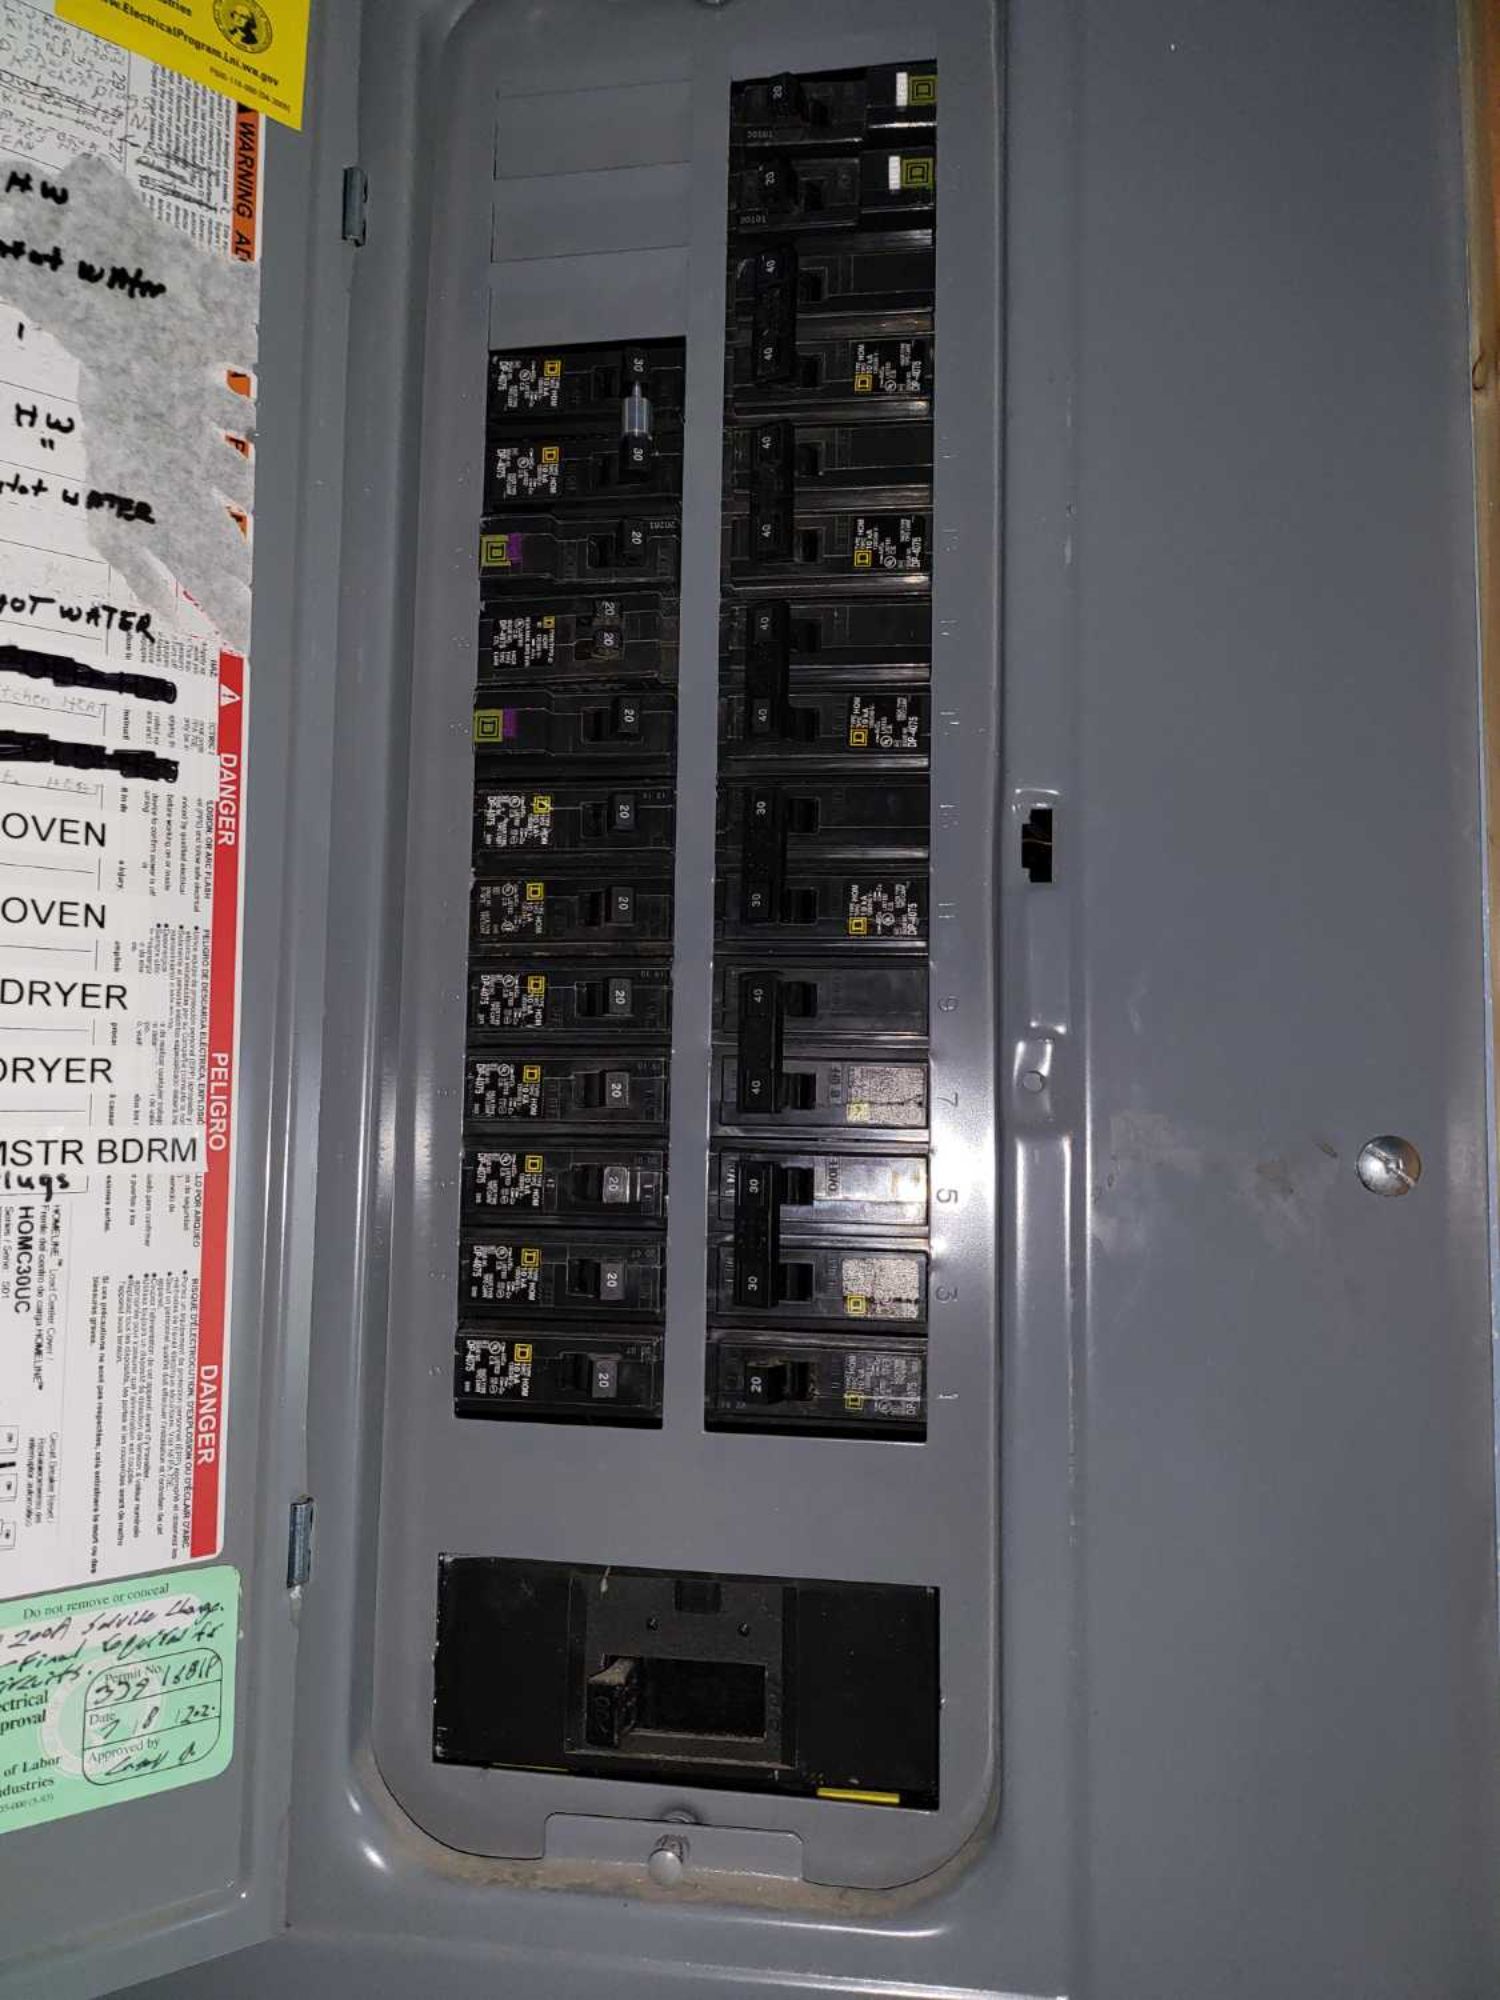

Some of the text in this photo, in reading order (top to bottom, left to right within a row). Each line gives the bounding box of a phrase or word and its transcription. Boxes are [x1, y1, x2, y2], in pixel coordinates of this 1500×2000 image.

[236, 122, 256, 219] WARNING
[633, 358, 644, 372] 30
[761, 436, 772, 449] 40
[633, 447, 643, 461] 30
[761, 523, 772, 537] 40
[632, 531, 642, 545] 20
[604, 601, 615, 616] 20
[760, 616, 769, 630] 40
[603, 632, 614, 646] 20
[624, 708, 635, 723] 20
[758, 708, 768, 722] 40
[218, 753, 238, 846] DANGER
[619, 804, 630, 819] 20
[756, 801, 766, 815] 30
[2, 813, 105, 848] OVEN
[618, 896, 629, 910] 20
[751, 893, 761, 907] 30
[1, 897, 105, 929] OVEN
[0, 978, 129, 1011] DRYER
[615, 990, 625, 1005] 20
[753, 988, 764, 1003] 40
[611, 1083, 622, 1098] 20
[751, 1080, 761, 1095] 40
[208, 1052, 230, 1151] PELIGRO
[936, 1093, 959, 1108] 7
[97, 1138, 198, 1164] BDRM
[608, 1176, 619, 1192] 20
[749, 1178, 759, 1193] 30
[936, 1188, 959, 1204] 5
[14, 1206, 35, 1314] HOMC30UC
[606, 1273, 617, 1288] 20
[747, 1275, 758, 1291] 30
[935, 1286, 959, 1304] 3
[598, 1373, 609, 1388] 20
[751, 1375, 762, 1393] 20
[196, 1363, 219, 1466] DANGER
[23, 1583, 170, 1619] Do not remove or conceal
[105, 1667, 142, 1683] Permit
[0, 1709, 47, 1736] proval
[89, 1712, 116, 1726] Date
[89, 1741, 146, 1764] Approved
[146, 1736, 161, 1751] by
[3, 1754, 62, 1777] of Labor
